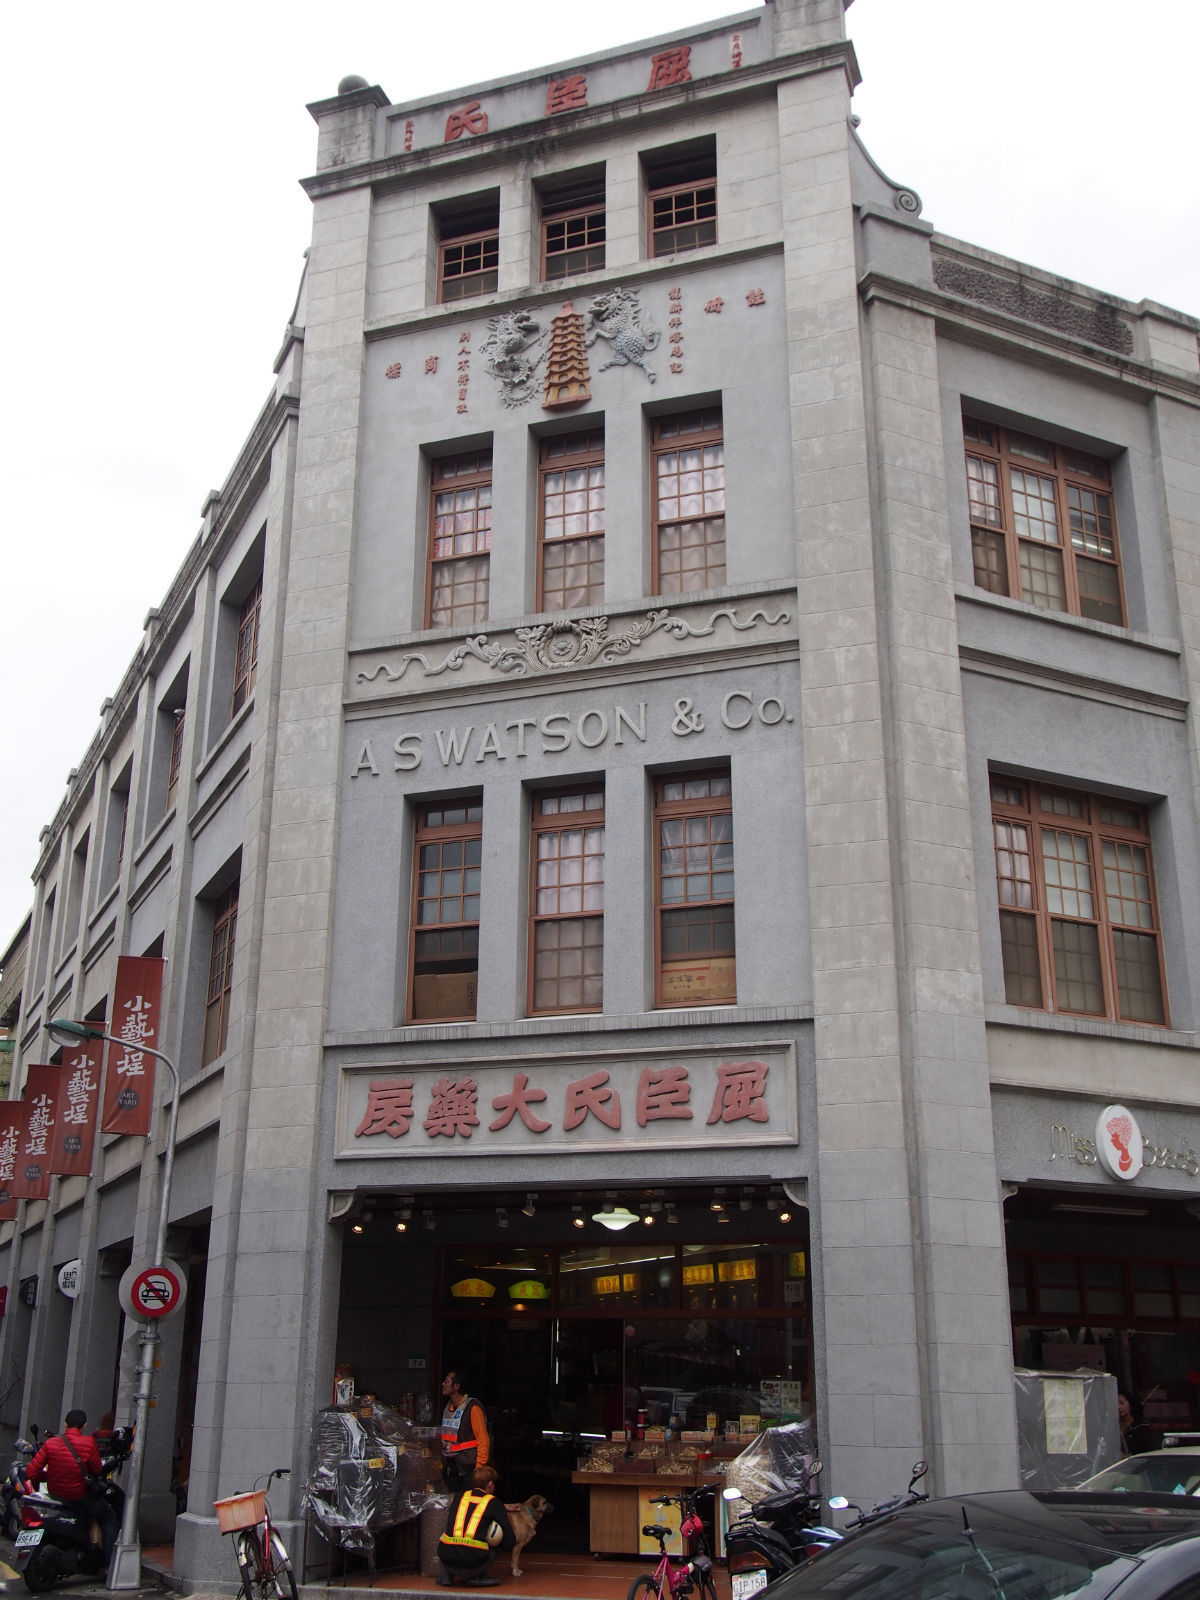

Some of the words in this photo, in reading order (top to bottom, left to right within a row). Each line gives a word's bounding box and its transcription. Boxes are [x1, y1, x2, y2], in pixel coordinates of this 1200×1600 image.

[350, 739, 379, 778] A
[394, 732, 422, 773] S
[434, 702, 648, 766] WATSON
[671, 697, 704, 737] &
[117, 995, 154, 1076] 小藝埕
[25, 1093, 55, 1156] 小藝埕
[63, 1054, 97, 1125] 小藝埕
[1048, 1124, 1097, 1168] Miss
